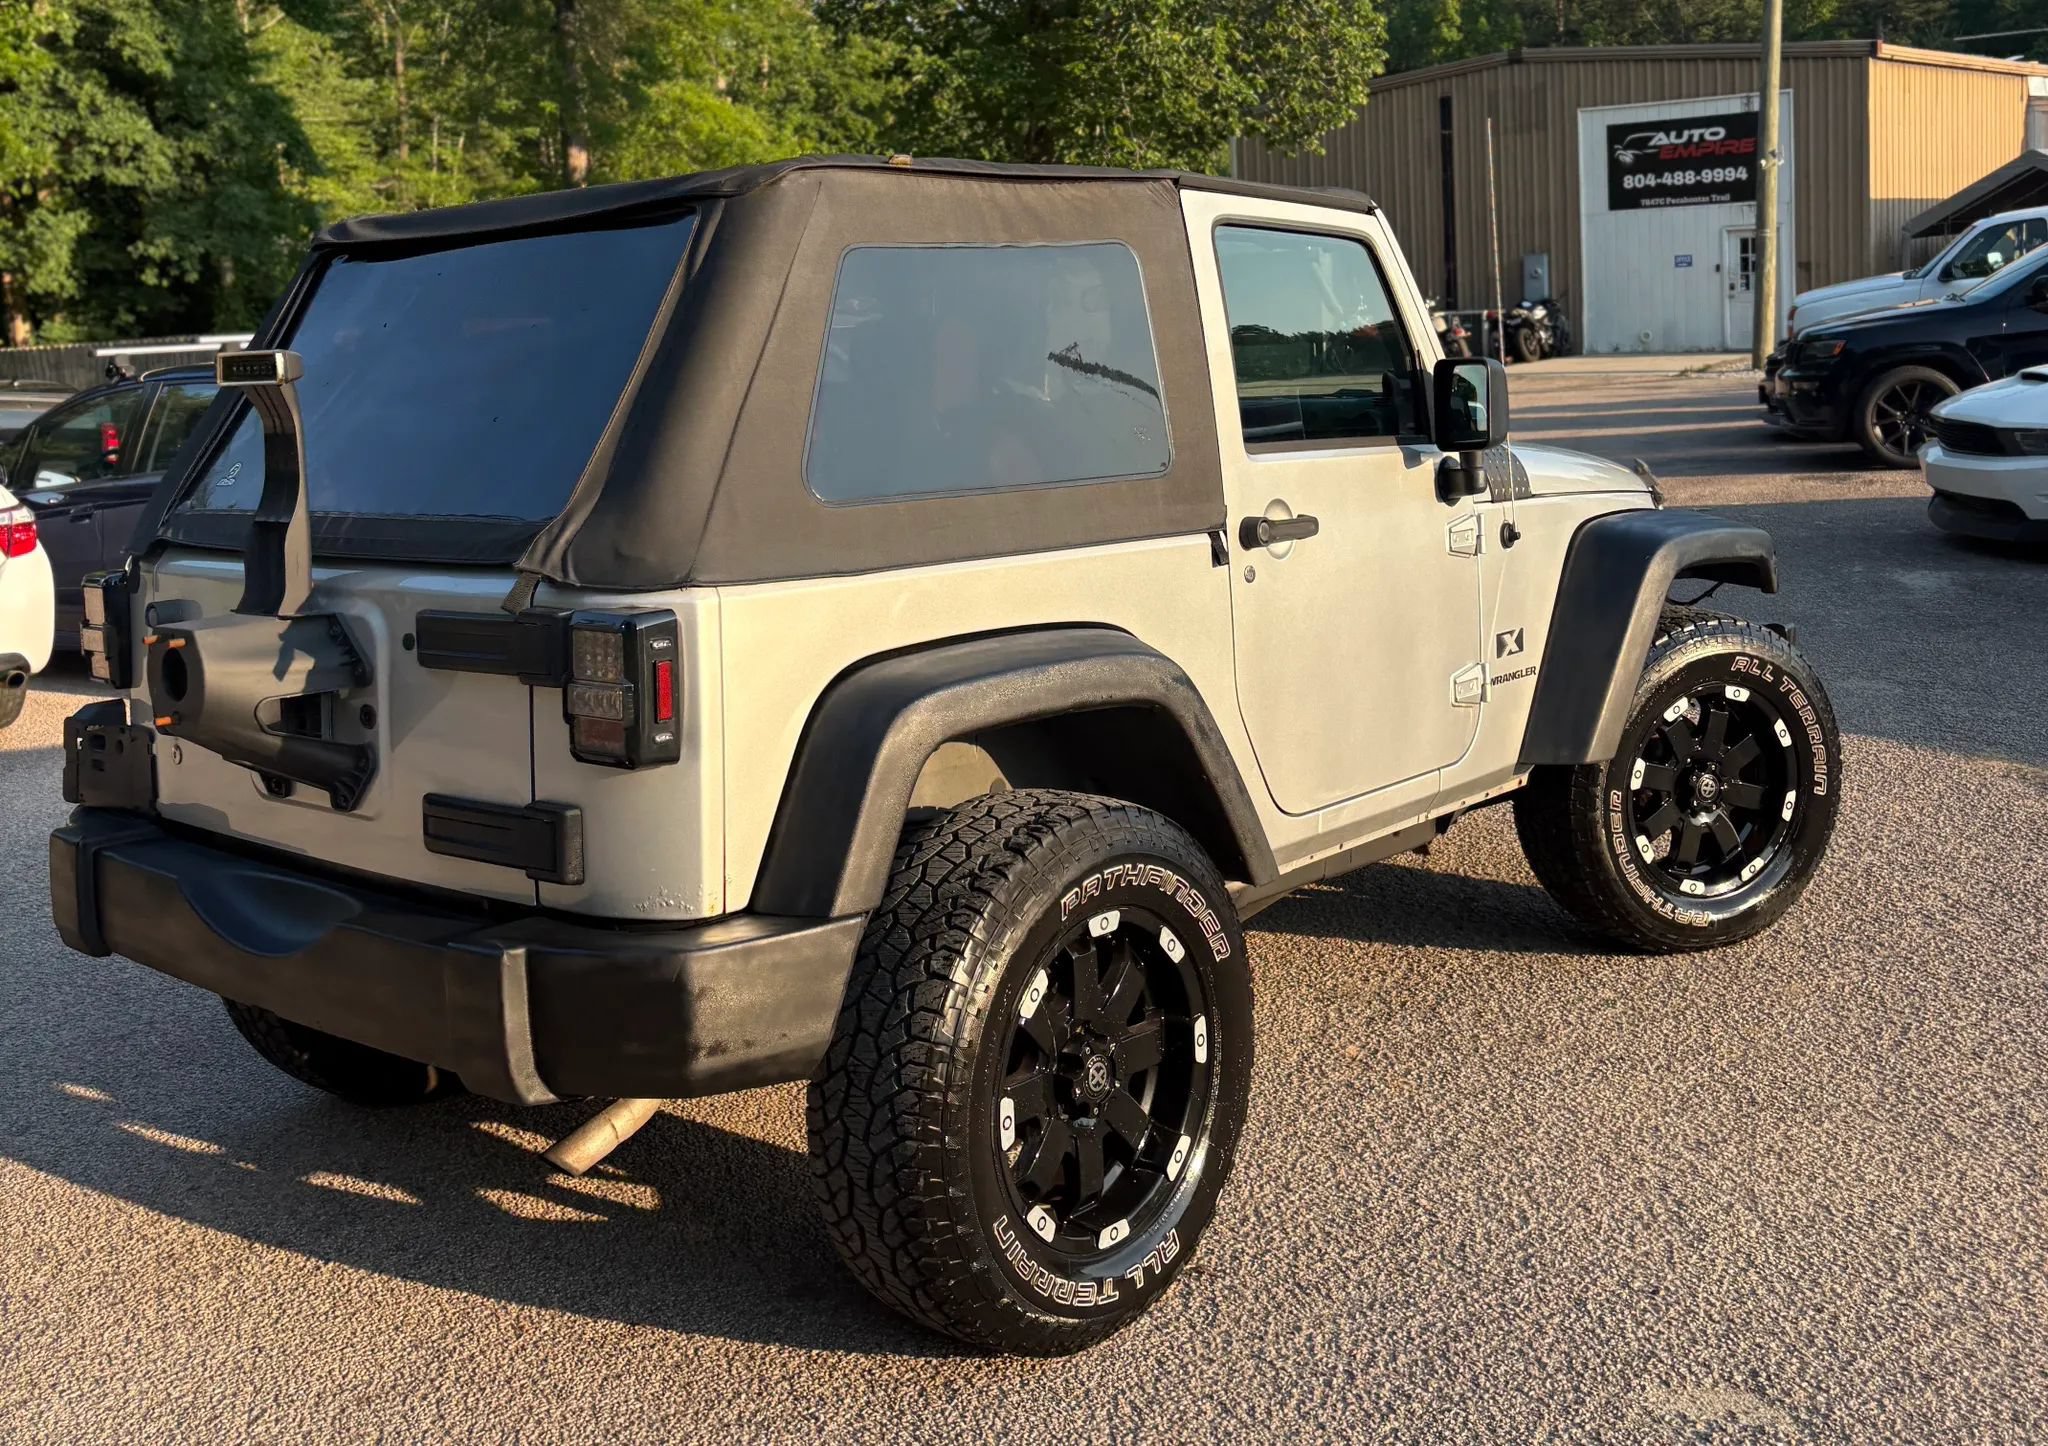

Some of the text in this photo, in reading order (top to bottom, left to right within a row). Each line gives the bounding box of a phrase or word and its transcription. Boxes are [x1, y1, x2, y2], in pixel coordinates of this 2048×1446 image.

[1646, 127, 1726, 146] AUTO
[1660, 137, 1758, 159] EMPIRE
[1623, 167, 1748, 188] 804-488-9994
[1711, 193, 1730, 202] Trail
[1491, 666, 1536, 686] WRANGLER
[1731, 655, 1774, 683] ALL
[1780, 675, 1828, 796] TERRAIN
[1609, 790, 1711, 928] PATHFINDER
[1060, 863, 1232, 963] PATHFINDER
[993, 1214, 1181, 1307] ALL TERRAIN
